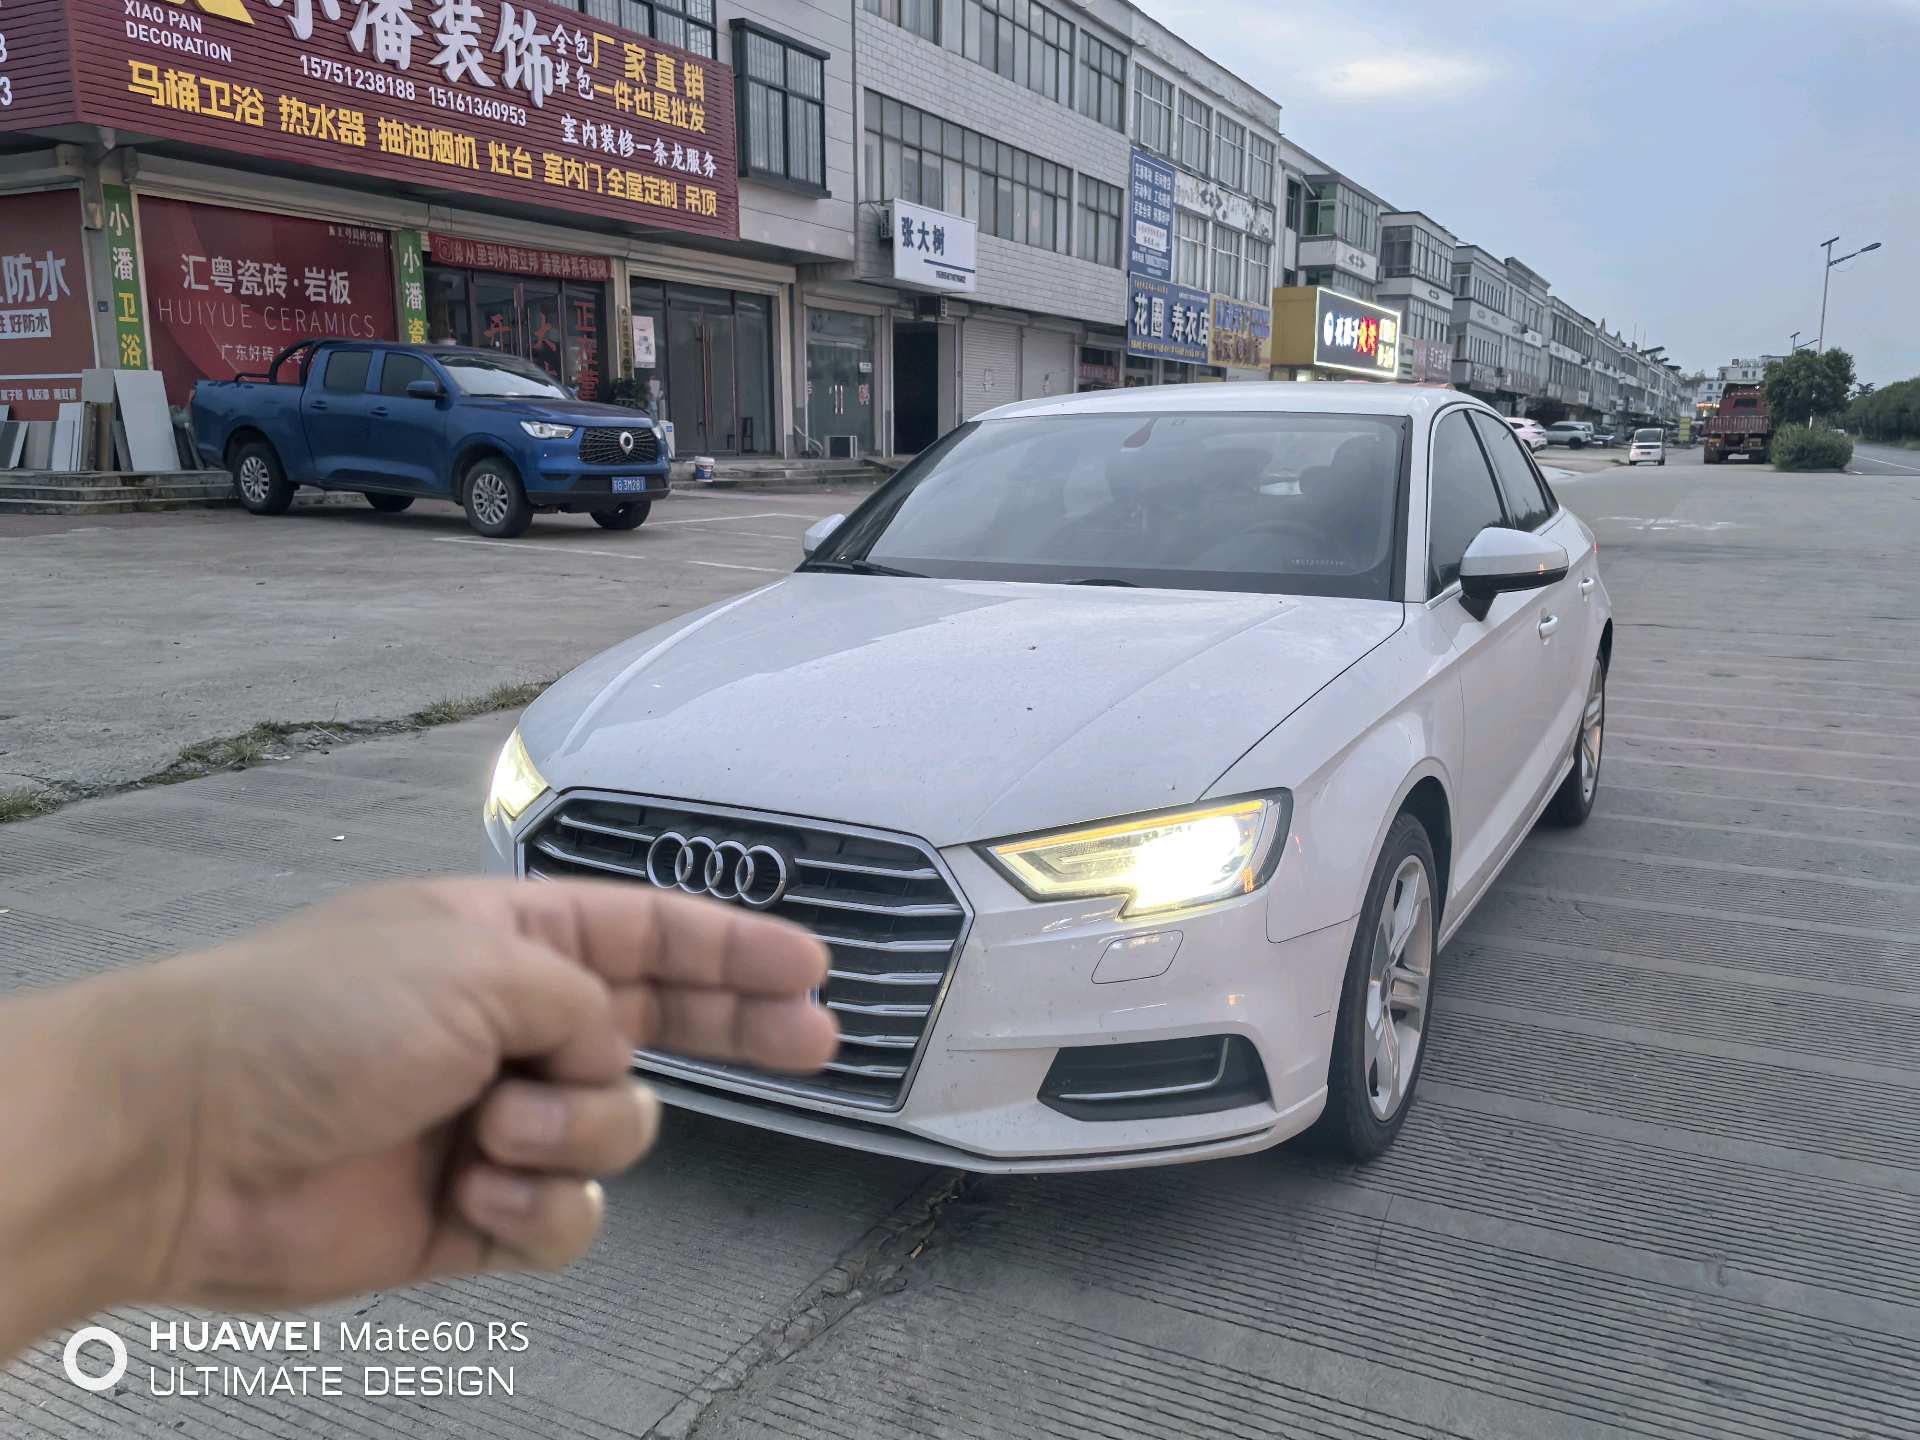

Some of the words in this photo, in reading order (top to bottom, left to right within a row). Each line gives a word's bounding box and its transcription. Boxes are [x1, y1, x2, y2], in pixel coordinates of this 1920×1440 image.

[125, 0, 164, 24] XIAO
[168, 11, 202, 34] PAN
[125, 21, 232, 63] DECORATION
[551, 24, 592, 65] 全包
[592, 31, 705, 103] 厂家直销
[299, 55, 416, 100] 15751238188
[428, 86, 527, 127] 15161360953
[553, 62, 594, 101] 半包
[594, 78, 706, 134] 一件也是批发
[127, 60, 265, 127] 马桶卫浴
[279, 95, 366, 147] 热水器
[378, 117, 479, 170] 抽油烟机
[488, 140, 533, 180] 灶台
[542, 152, 602, 194] 室内门
[606, 167, 678, 209] 全屋定制
[684, 184, 717, 217] 吊顶
[560, 114, 717, 179] 室内装修一条龙服务
[901, 216, 945, 257] 张大树
[0, 251, 70, 304] 防水
[108, 203, 144, 367] 小潘卫浴
[181, 254, 352, 305] 汇粤瓷砖·岩板
[159, 298, 250, 328] HUIYUE
[264, 305, 375, 338] CERAMICS
[1171, 302, 1208, 348] 寿衣店
